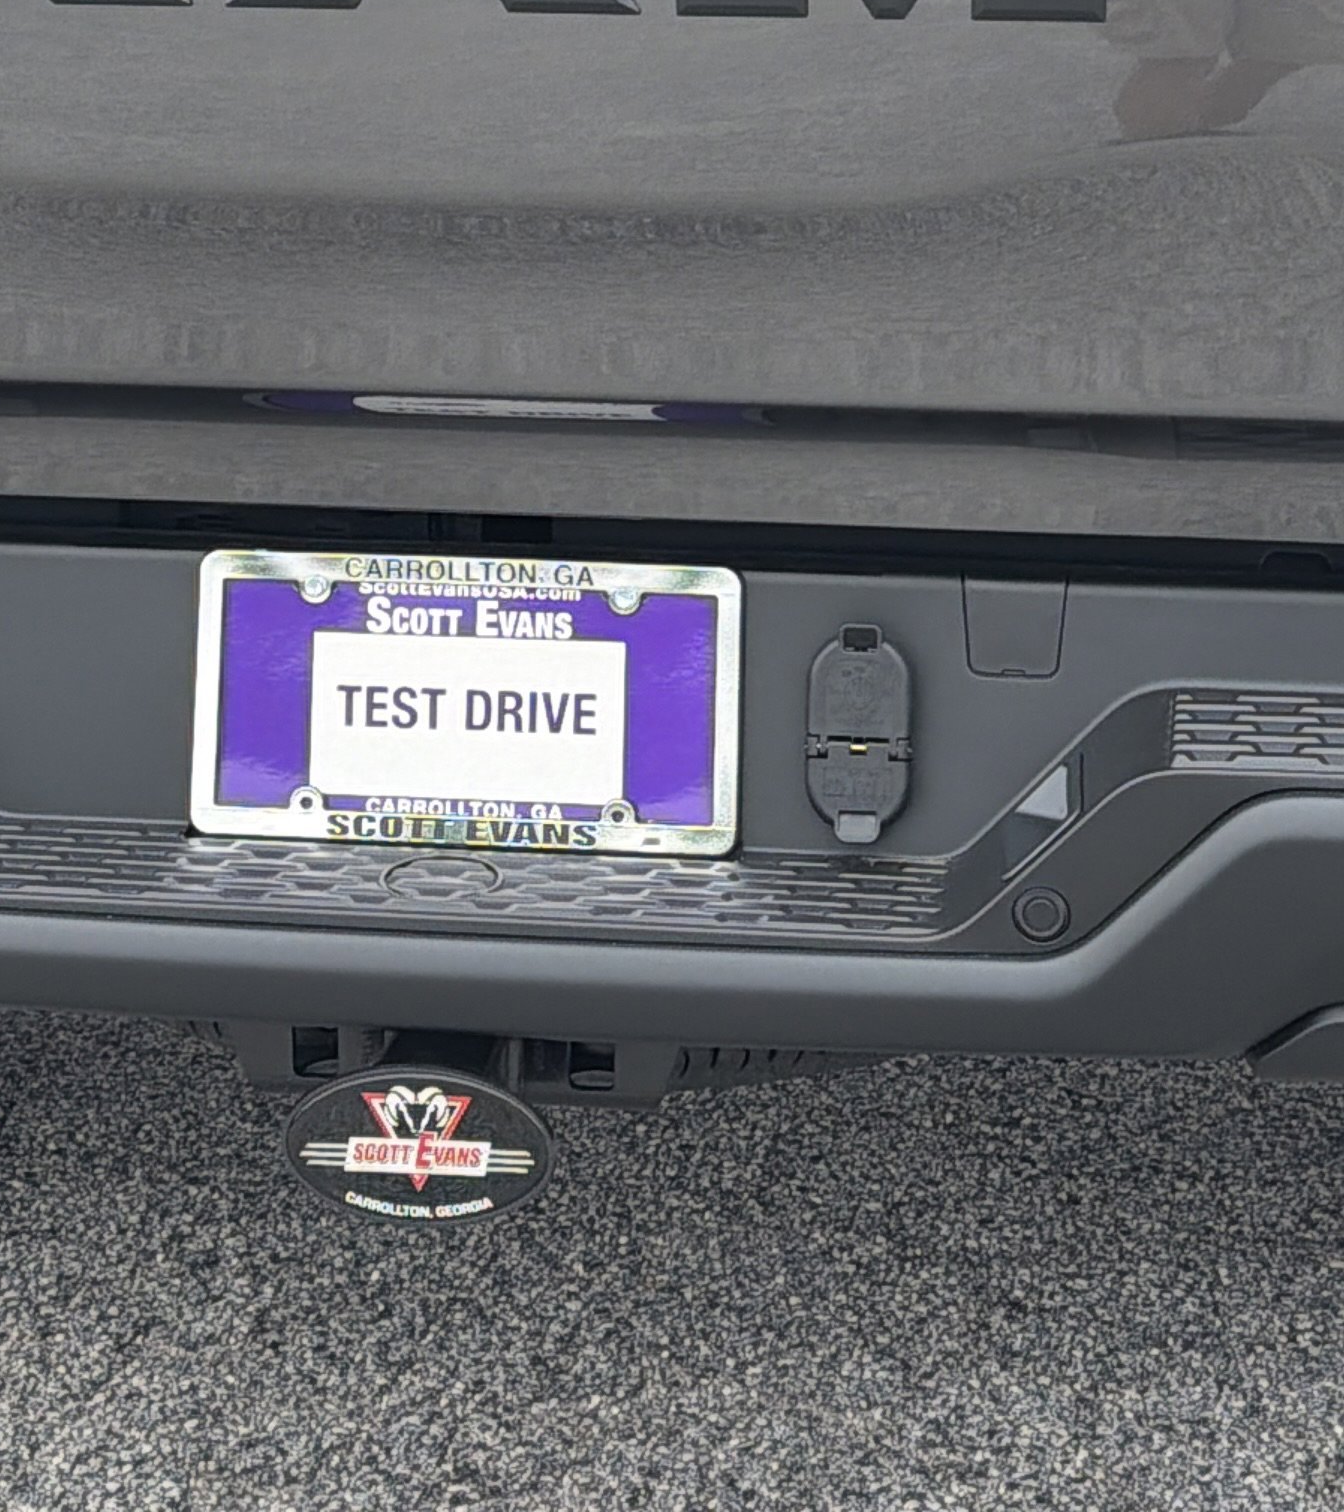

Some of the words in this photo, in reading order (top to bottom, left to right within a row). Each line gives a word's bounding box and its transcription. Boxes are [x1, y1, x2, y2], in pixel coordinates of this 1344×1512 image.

[554, 563, 595, 587] GA
[337, 685, 446, 731] TEST
[464, 689, 598, 736] DRIVE
[530, 803, 563, 820] GA
[326, 814, 456, 841] SCOTT
[465, 819, 598, 847] EVANS
[353, 1142, 415, 1164] SCOTT
[415, 1131, 484, 1170] EVANS
[435, 1197, 494, 1218] GEORGIA
